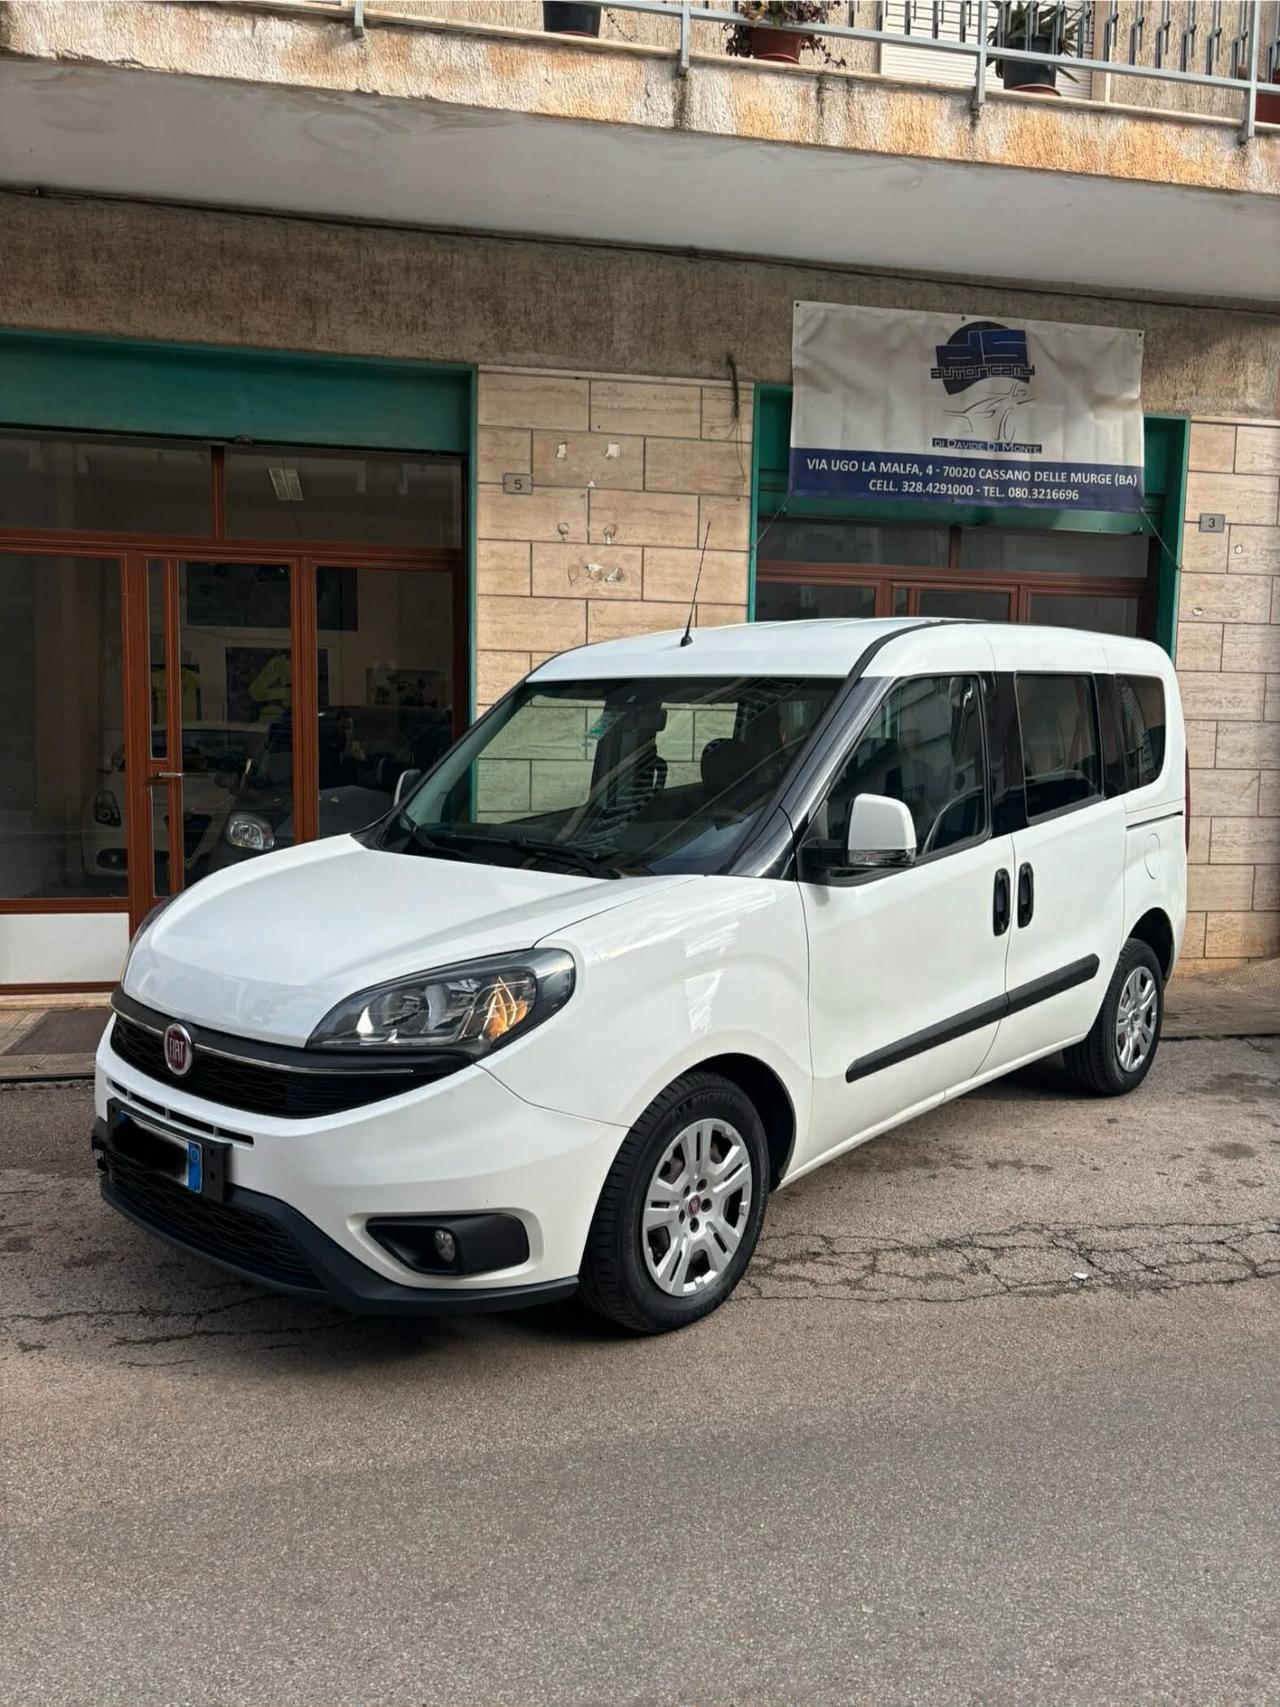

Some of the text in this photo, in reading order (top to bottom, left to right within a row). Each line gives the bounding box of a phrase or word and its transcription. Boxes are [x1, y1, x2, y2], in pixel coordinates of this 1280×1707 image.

[806, 458, 828, 470] VIA
[830, 459, 859, 472] UGO
[862, 461, 877, 473] LA
[879, 462, 923, 477] MALFA,
[925, 464, 933, 475] 4
[943, 465, 976, 479] 70020
[978, 469, 1032, 482] CASSANO
[1034, 471, 1067, 483] DELLE
[1070, 473, 1112, 485] MURGE
[1114, 473, 1138, 487] (BA)
[514, 479, 522, 490] 5
[869, 479, 898, 492] CELL.
[901, 481, 973, 496] 328.4291000
[983, 486, 1005, 498] TEL.
[1008, 487, 1080, 500] 080.3216696
[1208, 517, 1216, 528] 3
[169, 1036, 185, 1063] FIAT
